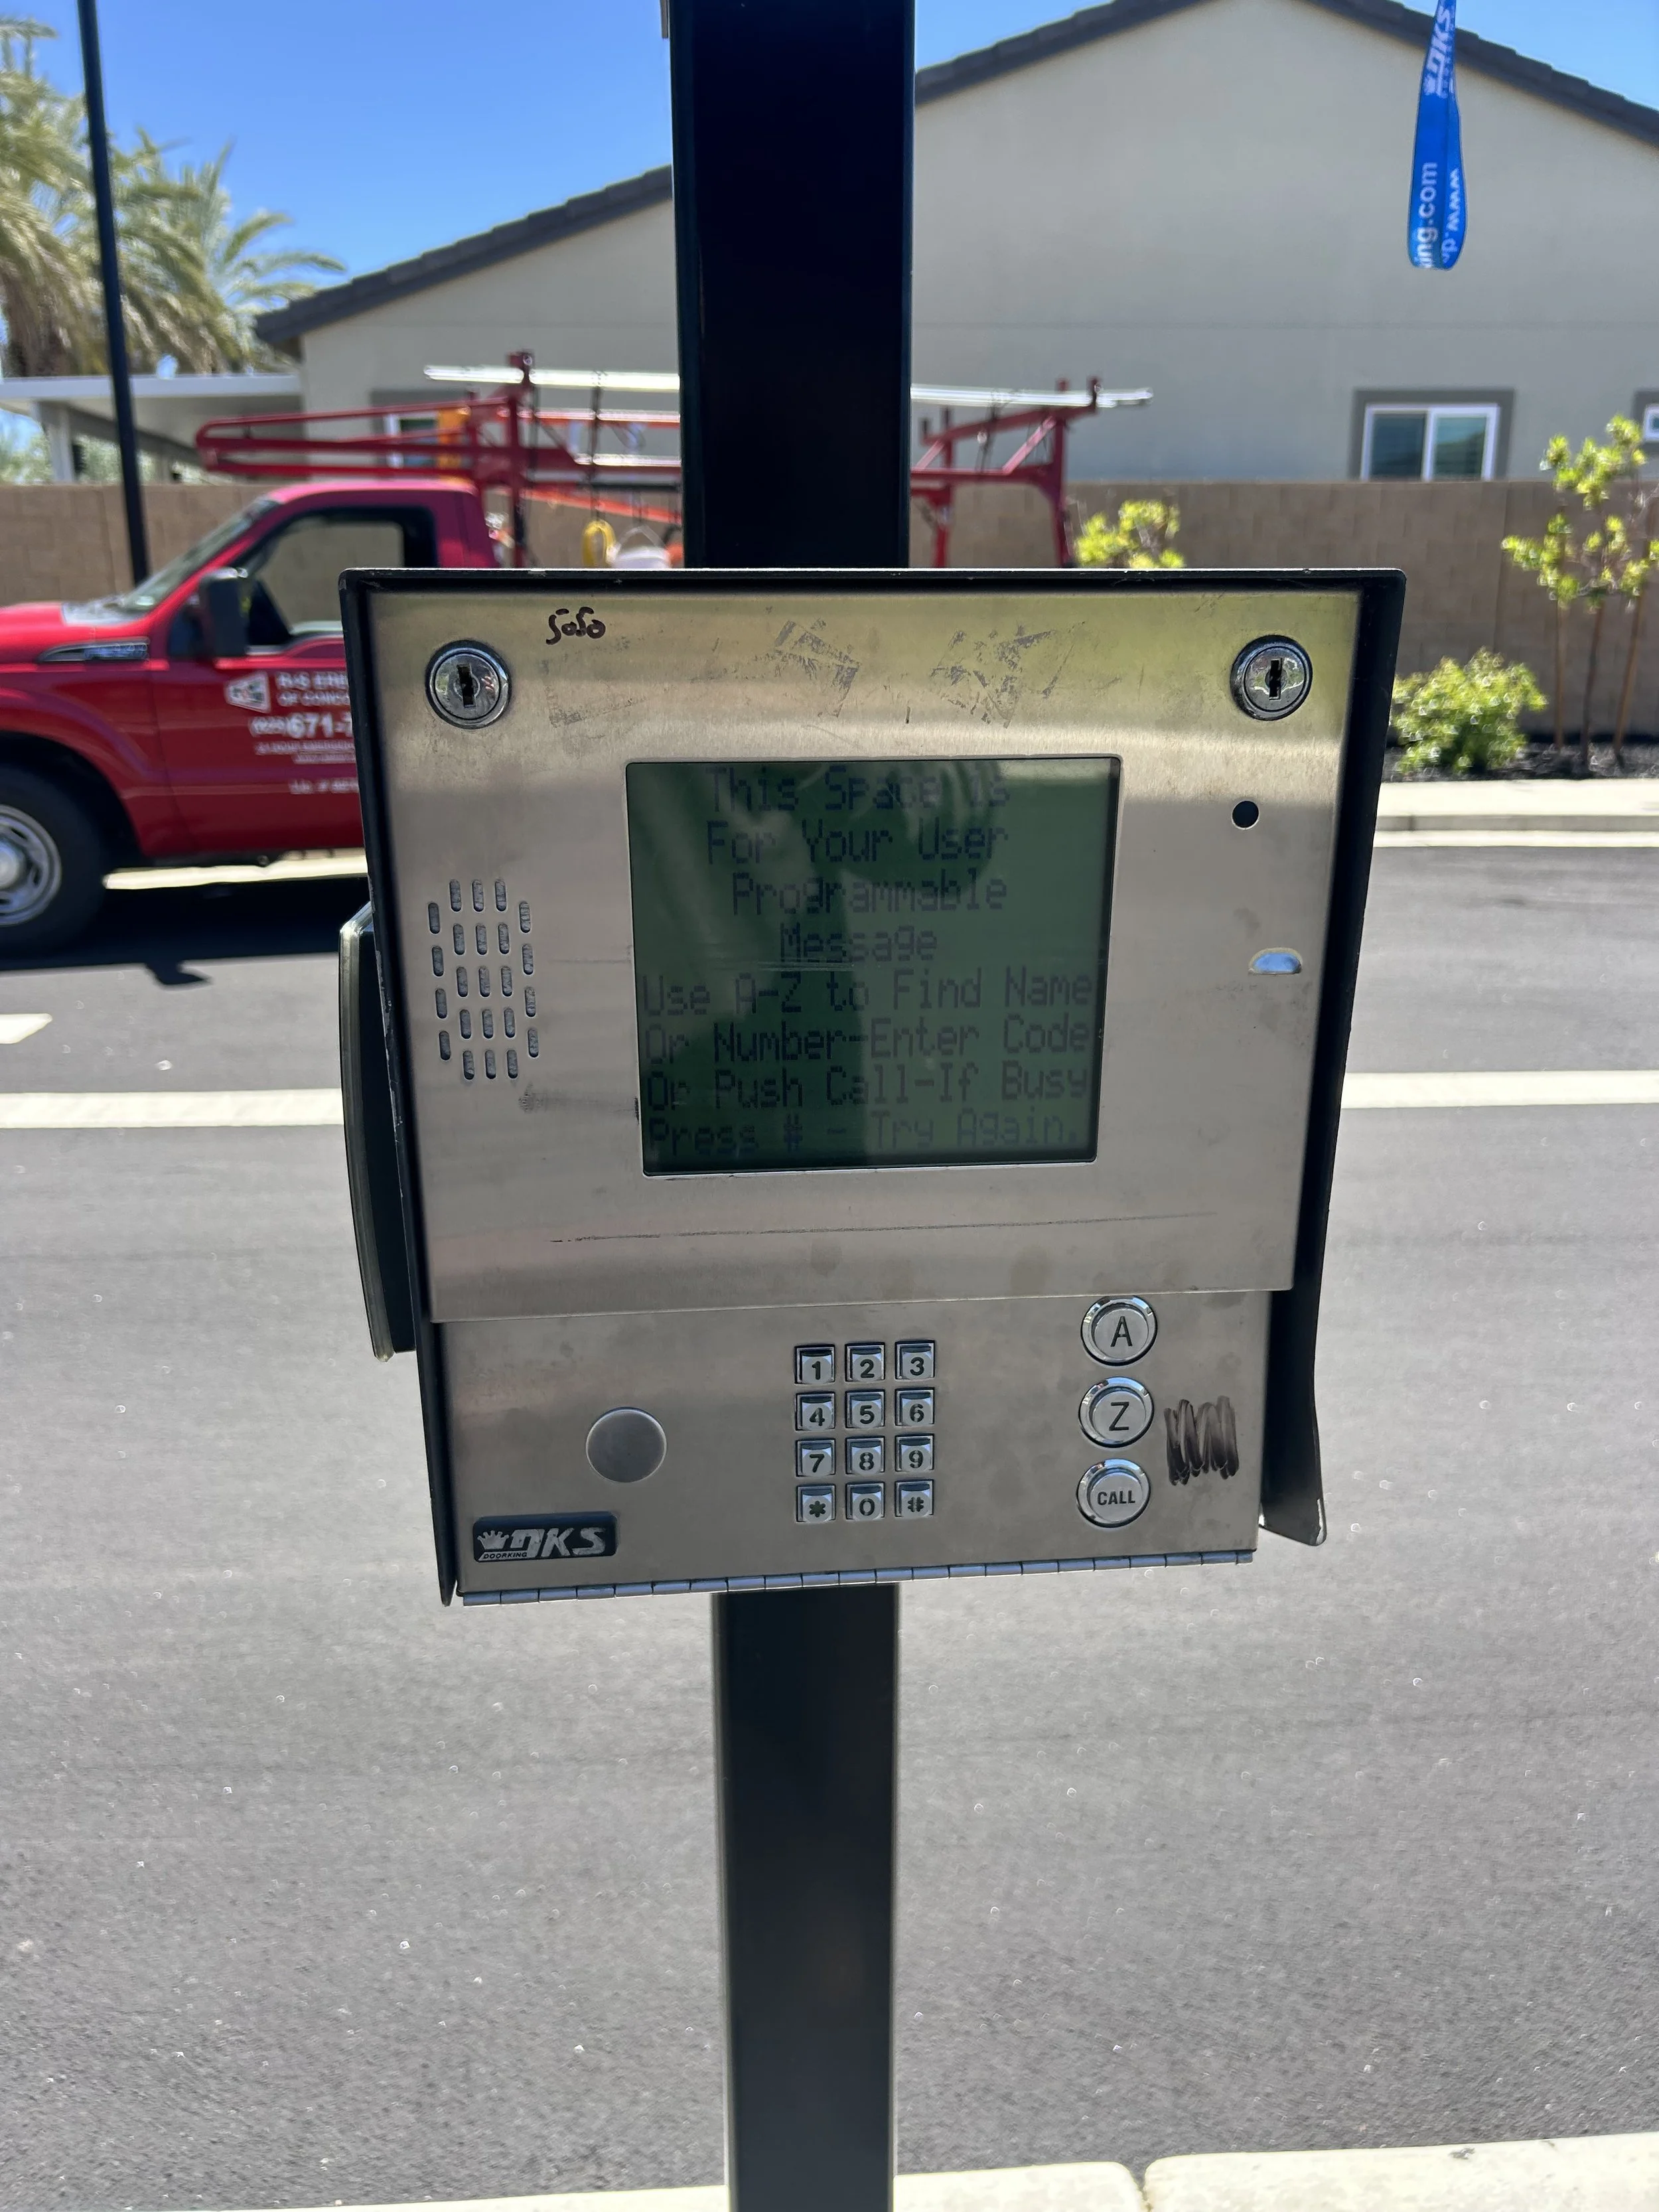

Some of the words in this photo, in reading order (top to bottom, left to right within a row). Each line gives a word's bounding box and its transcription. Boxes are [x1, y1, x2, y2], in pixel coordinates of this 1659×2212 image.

[1427, 6, 1451, 73] DKS
[1414, 162, 1438, 267] ing.com
[707, 767, 800, 812] This
[825, 765, 942, 811] Space
[707, 820, 776, 864] For
[802, 819, 893, 863] Your
[919, 817, 1009, 860] User
[733, 869, 1007, 915] Programmable
[780, 922, 938, 963] Message
[642, 976, 710, 1017] Use
[736, 971, 802, 1014] A-Z
[827, 971, 870, 1011] to
[894, 968, 981, 1009] Find
[1005, 966, 1092, 1007] Name
[646, 1025, 689, 1065] Or
[714, 1016, 980, 1063] Number-Enter
[1004, 1013, 1090, 1054] Code
[648, 1072, 691, 1112] Or
[715, 1069, 803, 1109] Push
[827, 1063, 979, 1106] Call-If
[1002, 1060, 1089, 1100] Busy
[649, 1117, 758, 1156] Press
[784, 1113, 803, 1154] #
[871, 1109, 934, 1151] Try
[958, 1107, 1078, 1148] Again.
[1110, 1316, 1133, 1347] A
[812, 1361, 821, 1380] 1
[860, 1359, 875, 1378] 2
[910, 1357, 924, 1376] 3
[809, 1407, 825, 1426] 4
[859, 1405, 875, 1424] 5
[910, 1404, 924, 1422] 6
[1109, 1402, 1129, 1432] Z
[809, 1453, 825, 1473] 7
[859, 1452, 875, 1471] 8
[908, 1450, 924, 1468] 9
[907, 1497, 924, 1512] #
[1097, 1490, 1136, 1506] CALL
